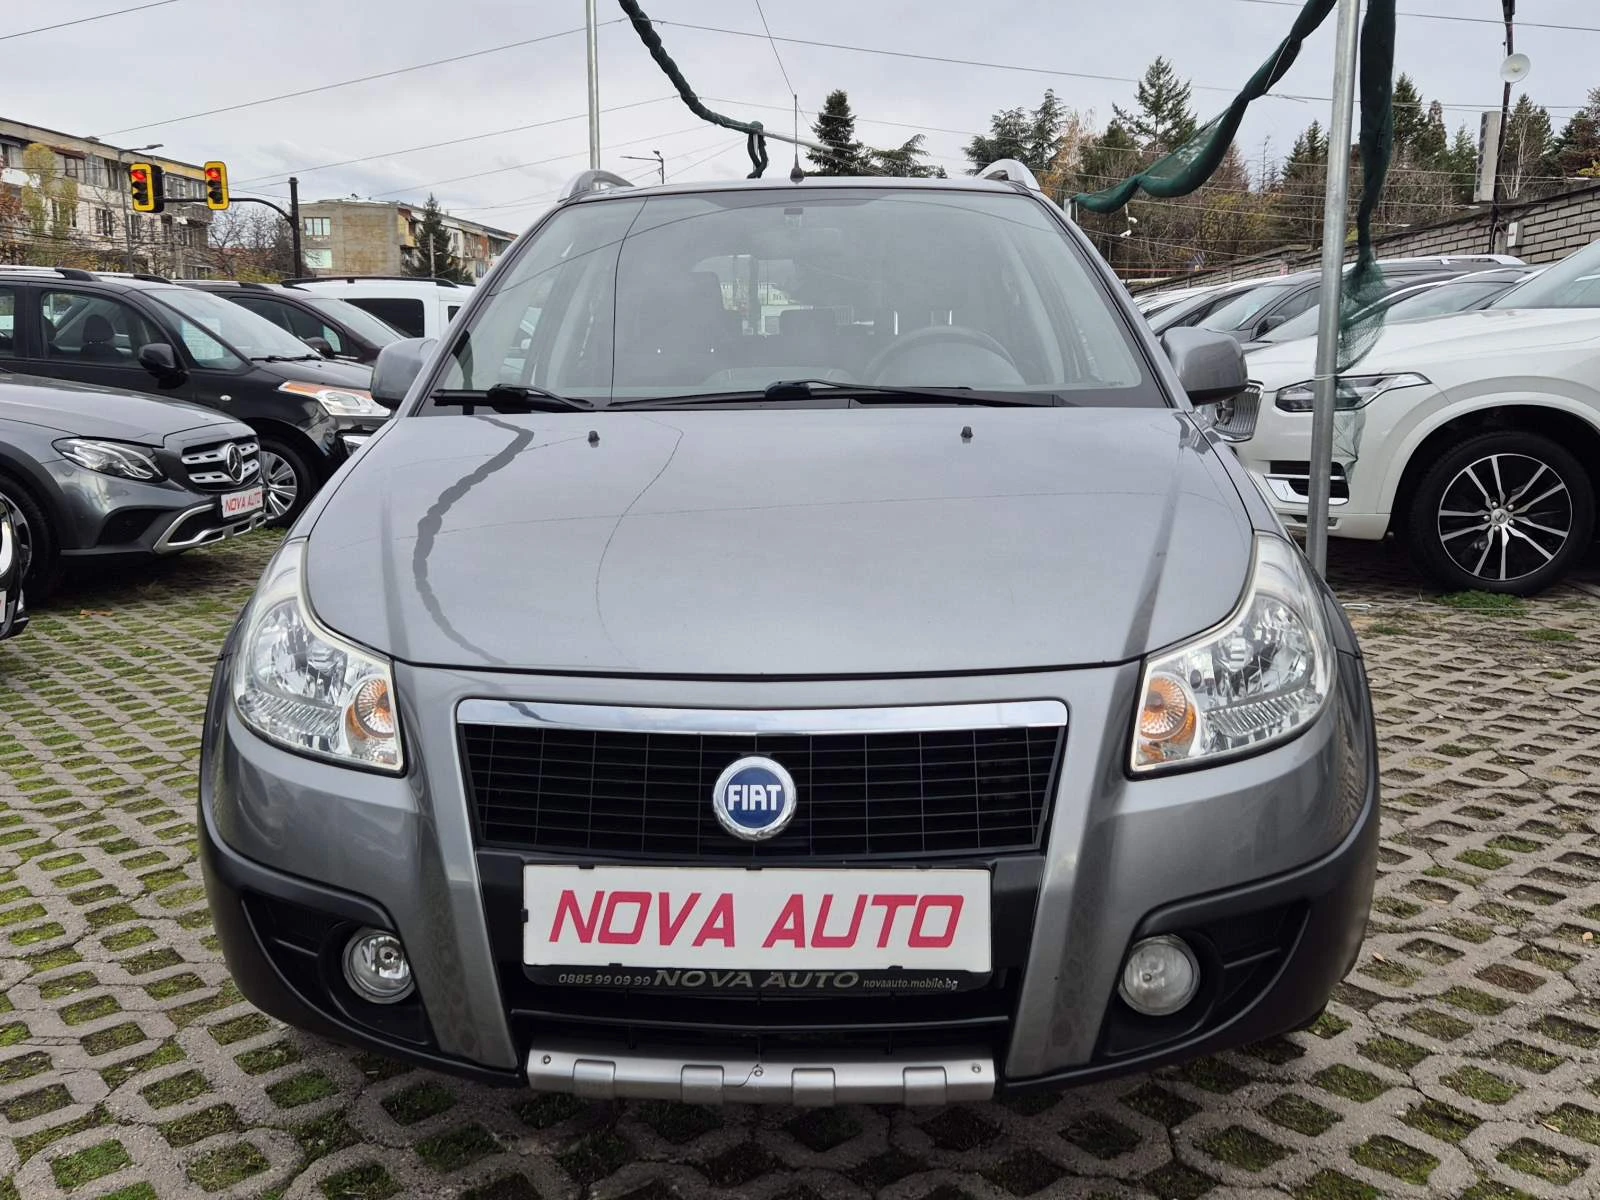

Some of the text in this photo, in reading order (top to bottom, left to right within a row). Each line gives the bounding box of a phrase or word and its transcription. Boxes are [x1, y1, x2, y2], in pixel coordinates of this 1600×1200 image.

[225, 496, 246, 512] NOVA
[727, 784, 782, 811] FIAT
[549, 889, 964, 948] NOVA AUTO
[558, 969, 959, 991] 0885 99 09 99 NOVA AUTO novaauto.mobile.bg
